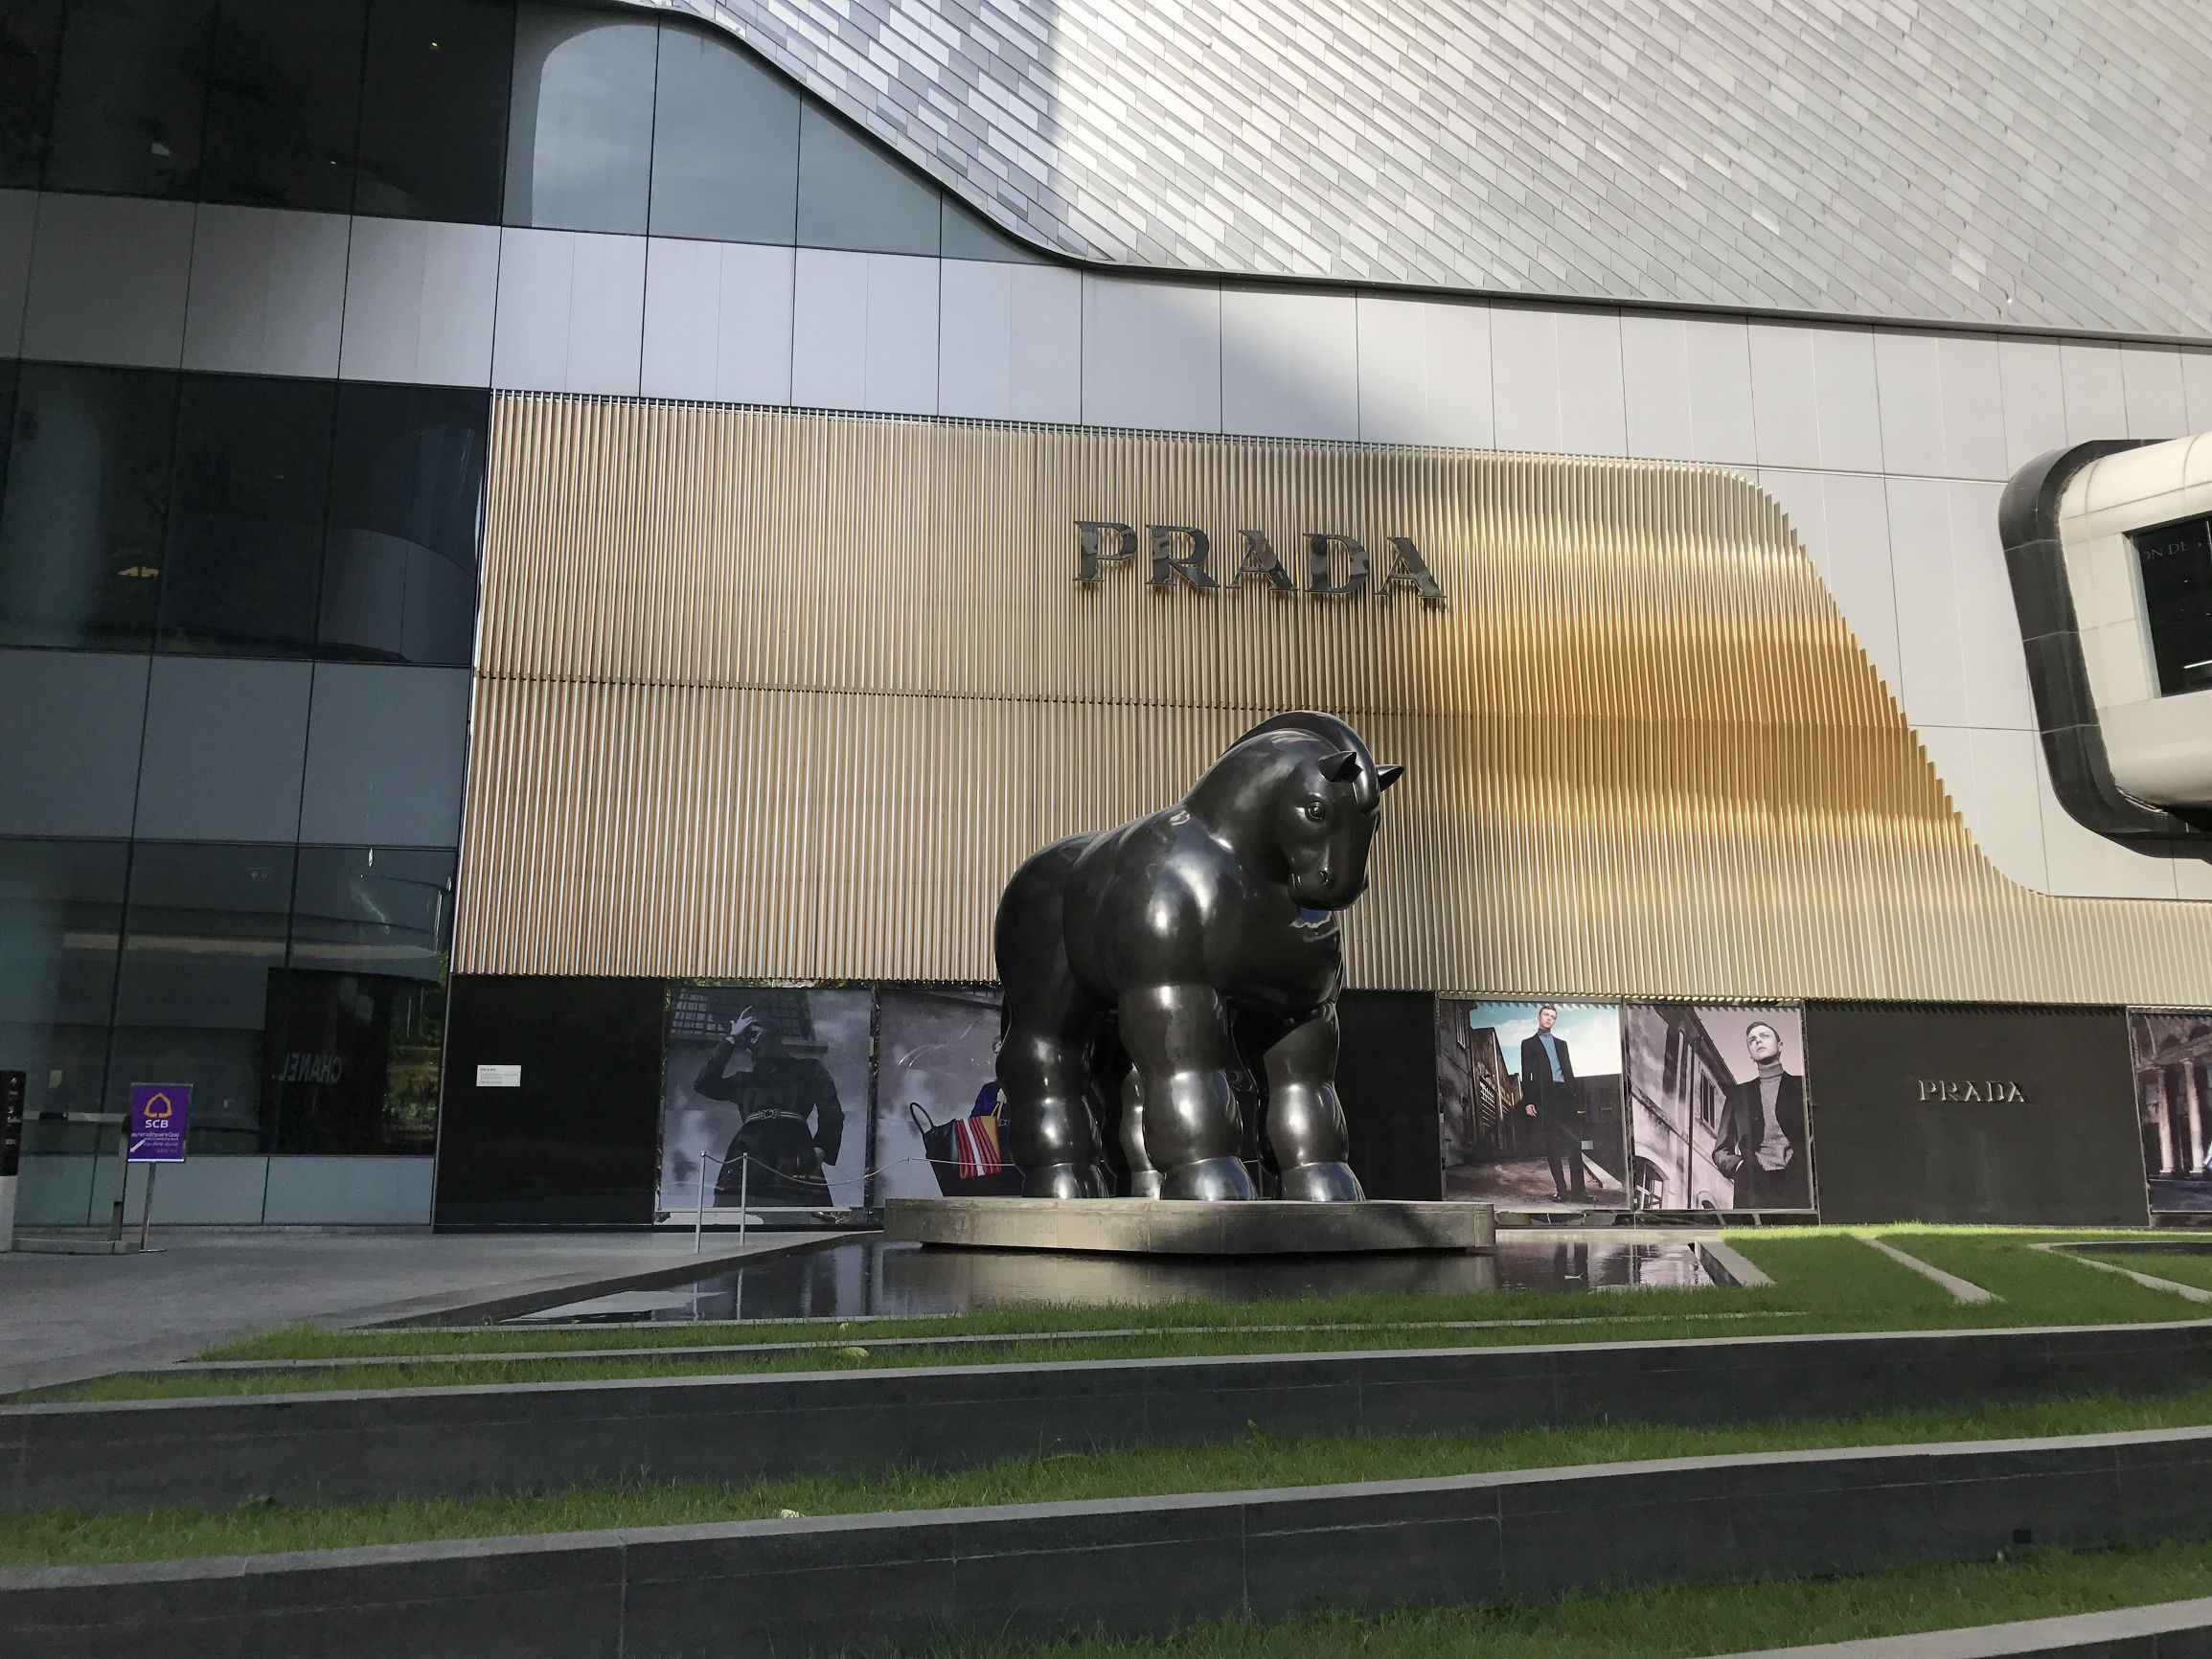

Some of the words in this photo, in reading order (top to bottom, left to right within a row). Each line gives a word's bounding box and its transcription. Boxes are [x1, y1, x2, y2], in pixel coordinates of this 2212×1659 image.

[1072, 520, 1448, 598] PRADA
[1917, 1079, 2025, 1102] PRADA
[145, 1119, 170, 1128] SCB
